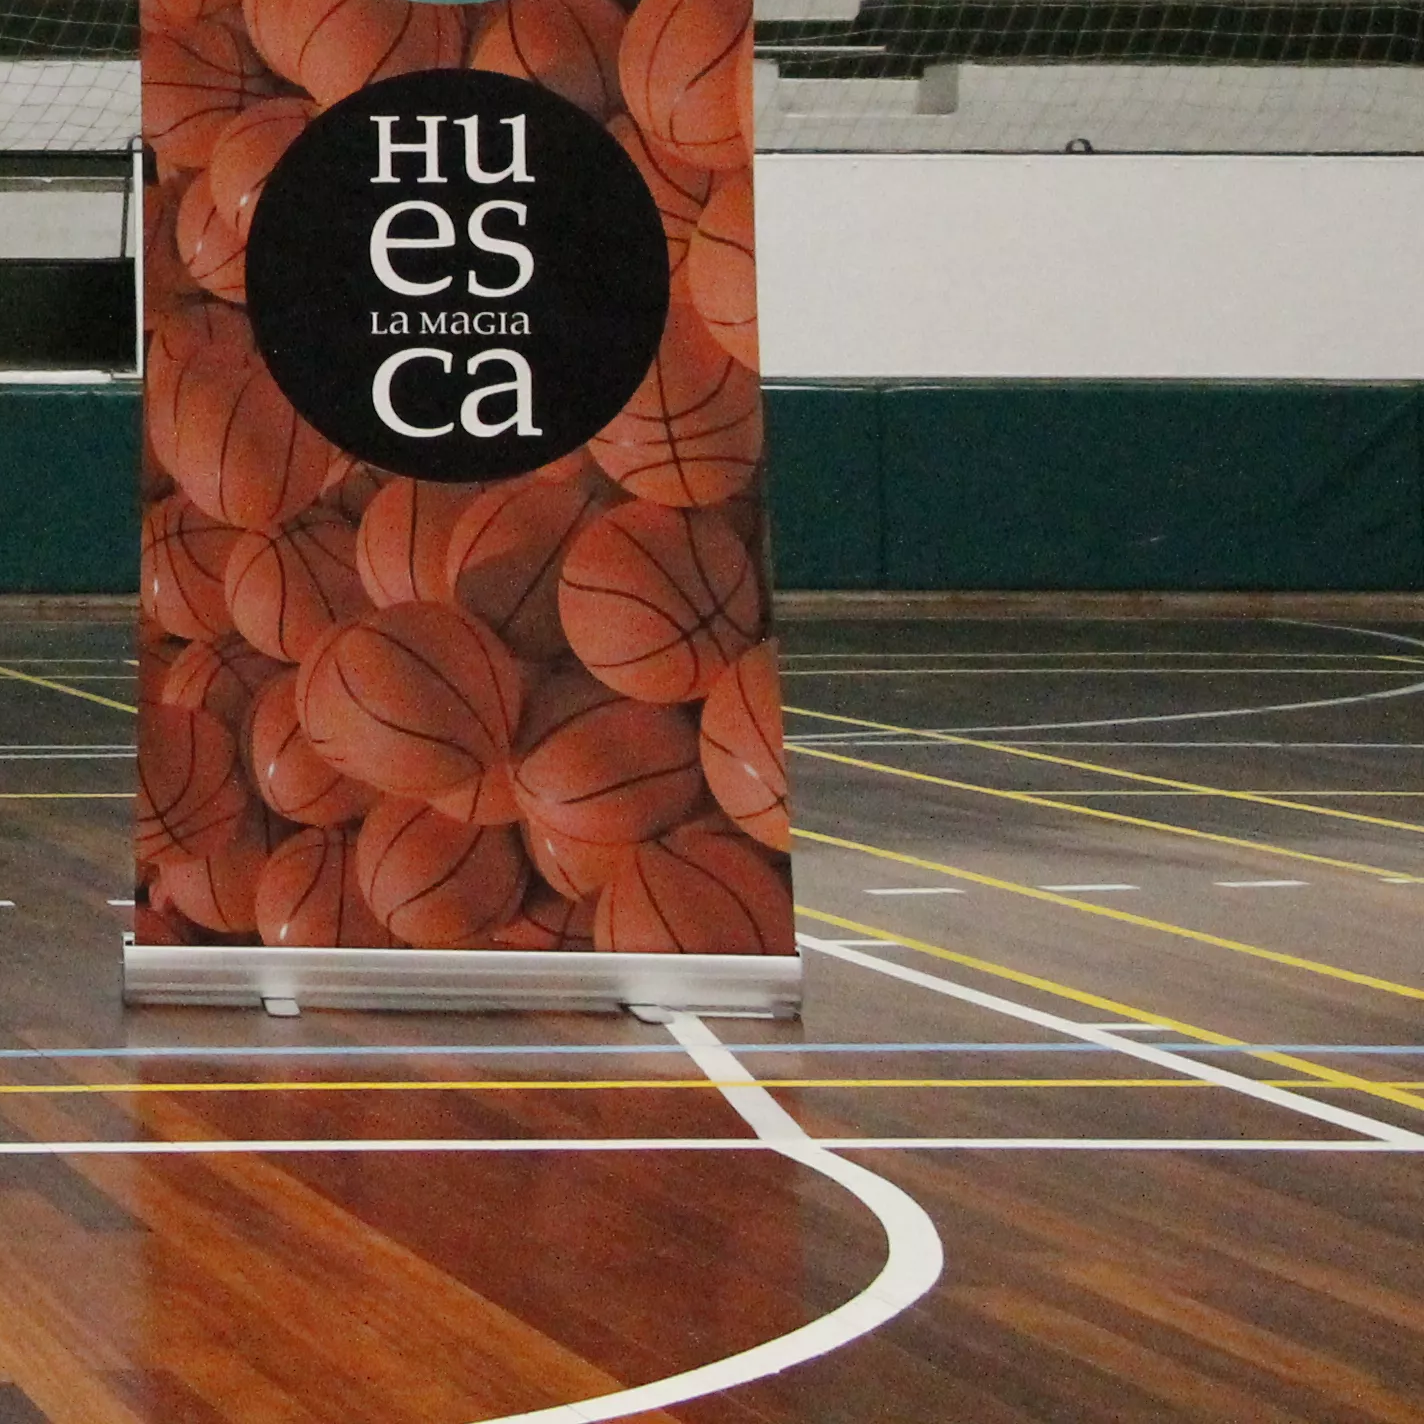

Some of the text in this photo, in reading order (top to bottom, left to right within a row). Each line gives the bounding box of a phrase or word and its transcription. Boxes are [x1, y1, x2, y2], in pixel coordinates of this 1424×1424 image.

[369, 200, 535, 297] es
[371, 311, 409, 335] La
[371, 347, 543, 438] ca
